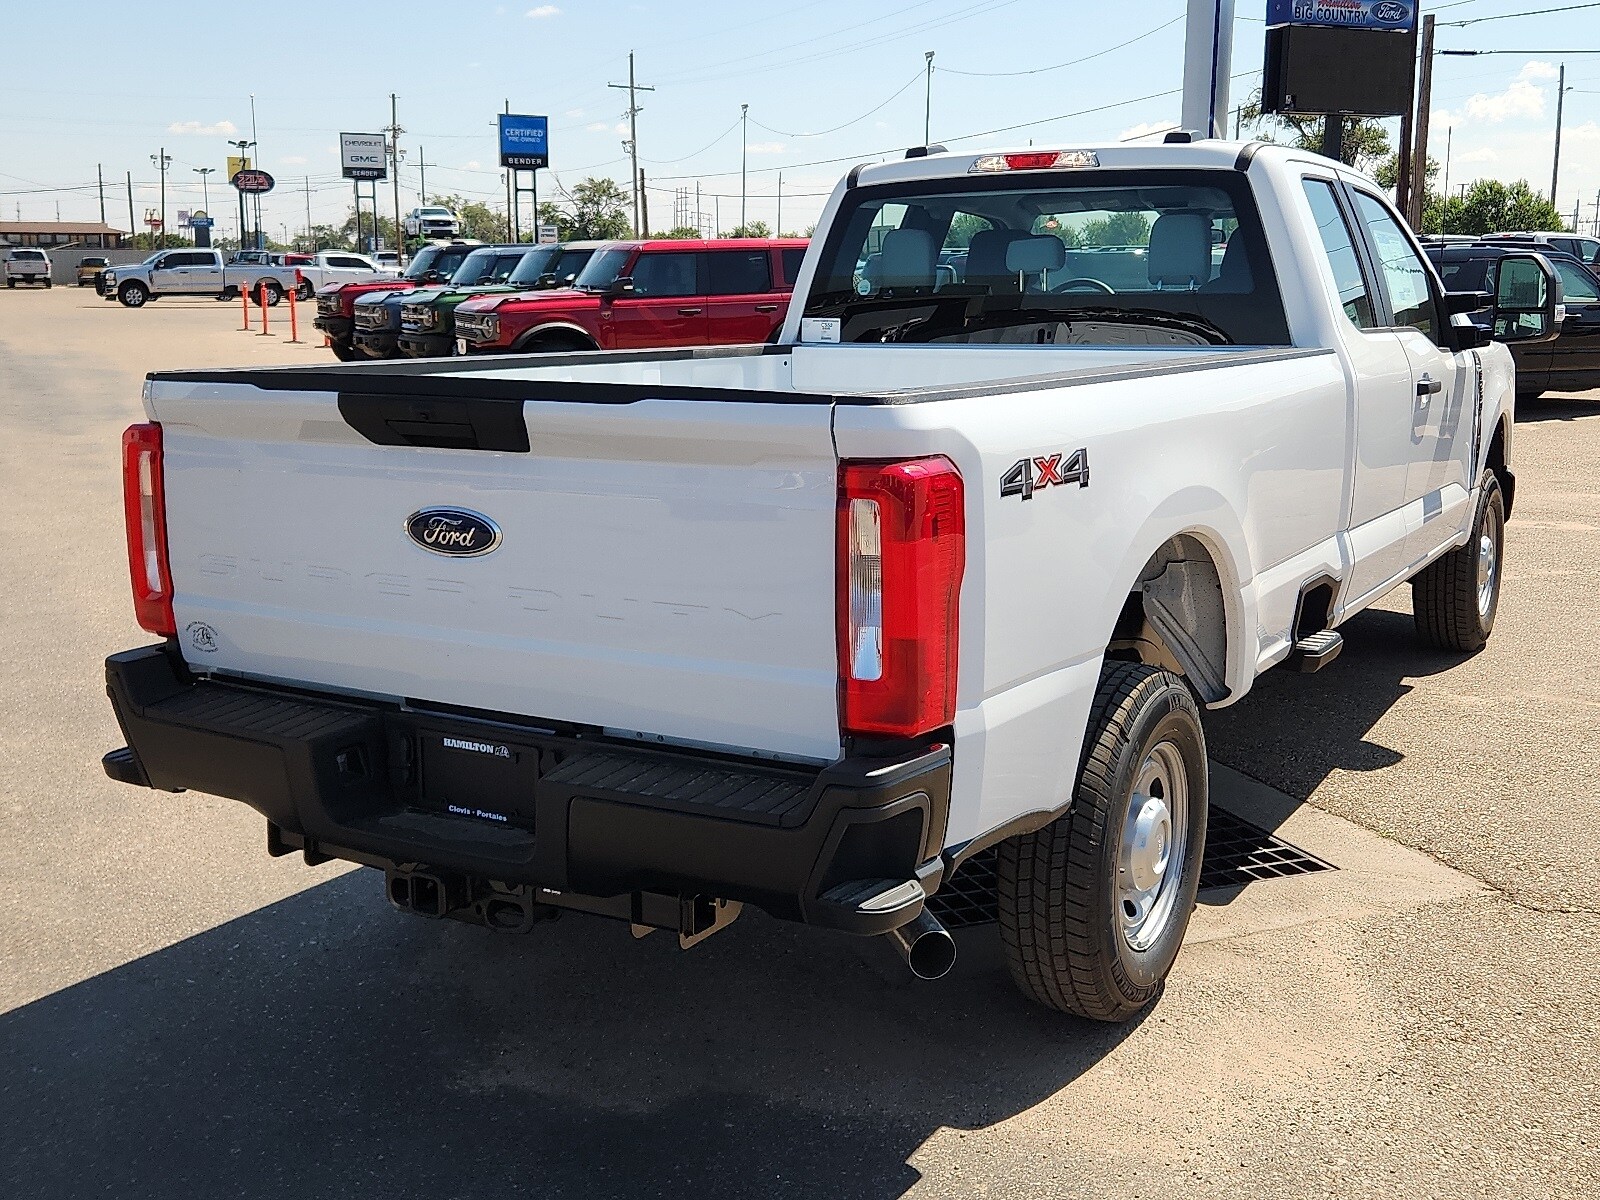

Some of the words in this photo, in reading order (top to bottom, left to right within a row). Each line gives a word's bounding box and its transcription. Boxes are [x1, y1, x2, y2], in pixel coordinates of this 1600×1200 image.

[1294, 7, 1313, 19] BIG
[1316, 8, 1368, 23] COUNTRY
[1377, 4, 1401, 20] Ford
[505, 129, 543, 137] CERTIFIED
[508, 157, 542, 165] BENDER
[424, 516, 476, 547] Ford
[443, 738, 494, 753] HAMILTON
[448, 804, 471, 815] Clovis
[476, 809, 507, 822] Portales
